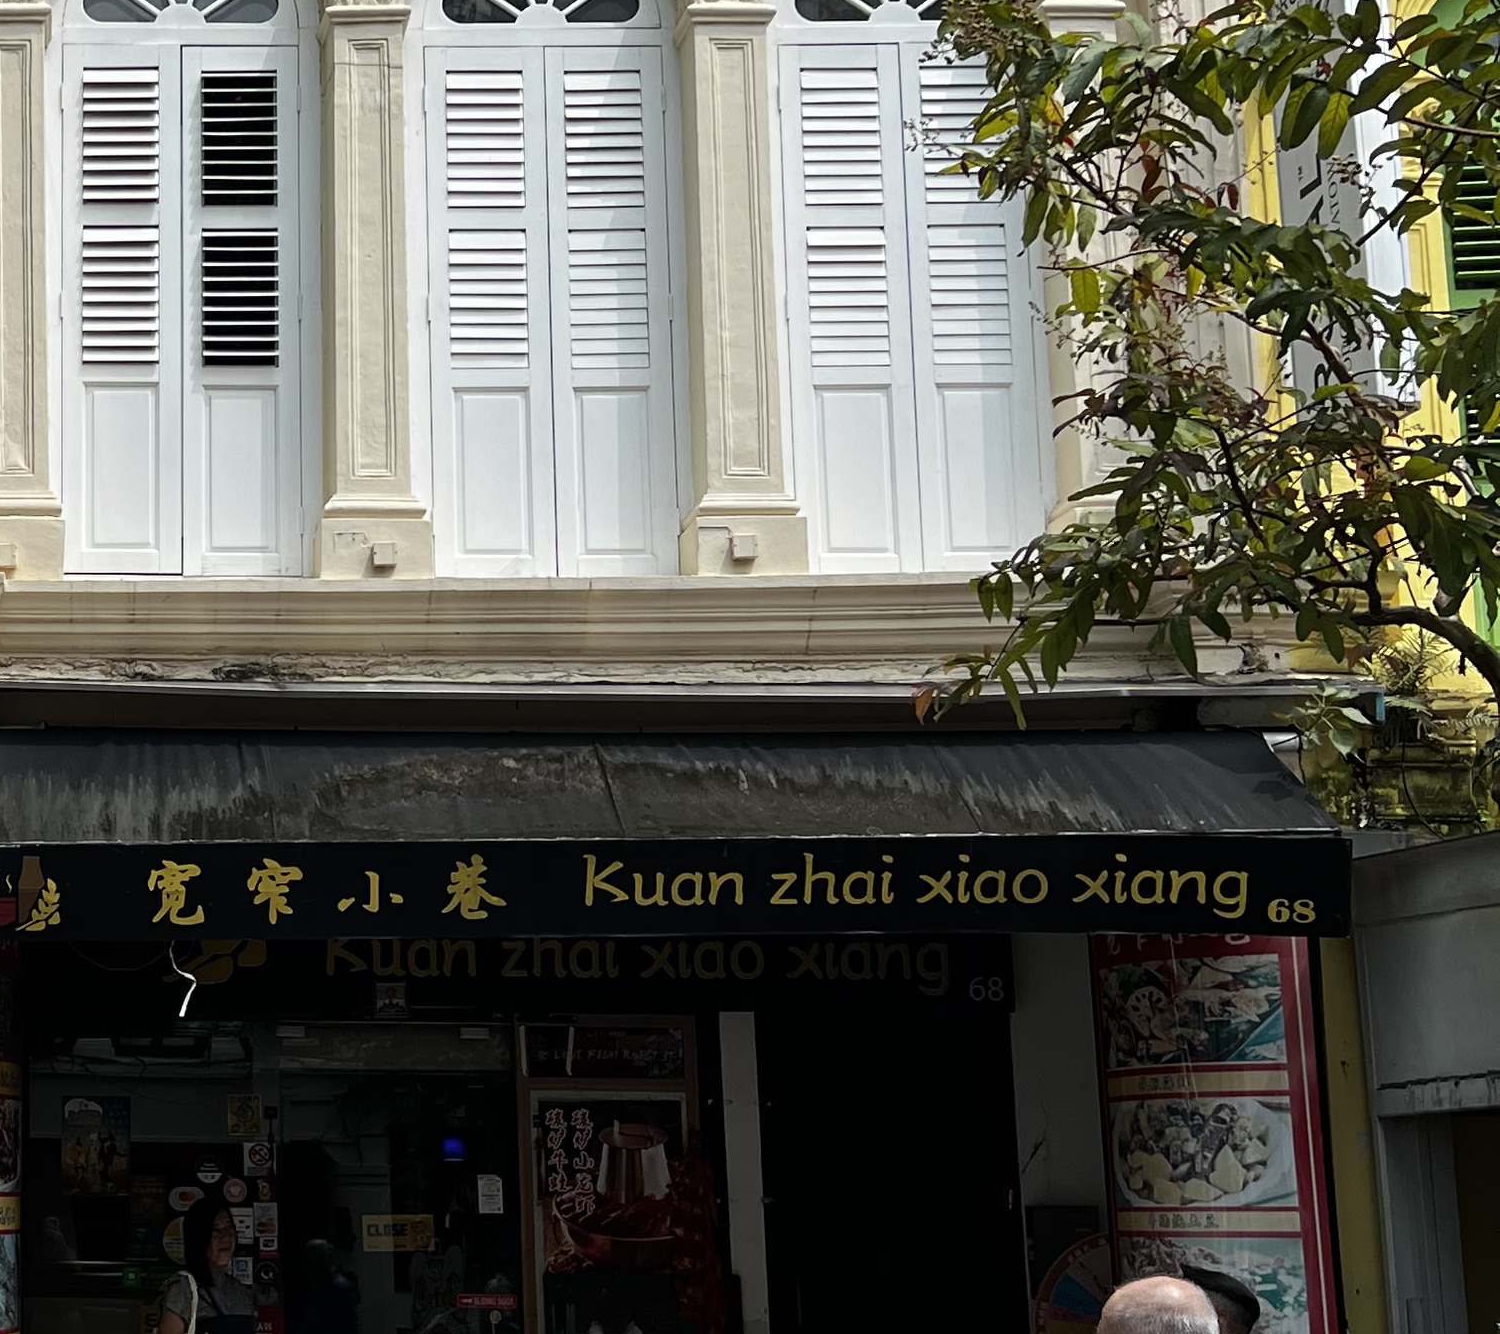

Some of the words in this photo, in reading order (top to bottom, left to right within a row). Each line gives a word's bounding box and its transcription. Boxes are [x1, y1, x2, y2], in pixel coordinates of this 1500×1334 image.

[583, 854, 744, 907] Kuan
[770, 852, 894, 905] zhai
[917, 854, 1049, 905] xiao
[1073, 853, 1248, 919] xiang
[1266, 898, 1316, 924] 68
[325, 938, 477, 978] Kuan
[501, 936, 619, 979] zhai
[641, 937, 766, 980] xiao
[786, 938, 950, 995] xiang
[968, 976, 1006, 1003] 68
